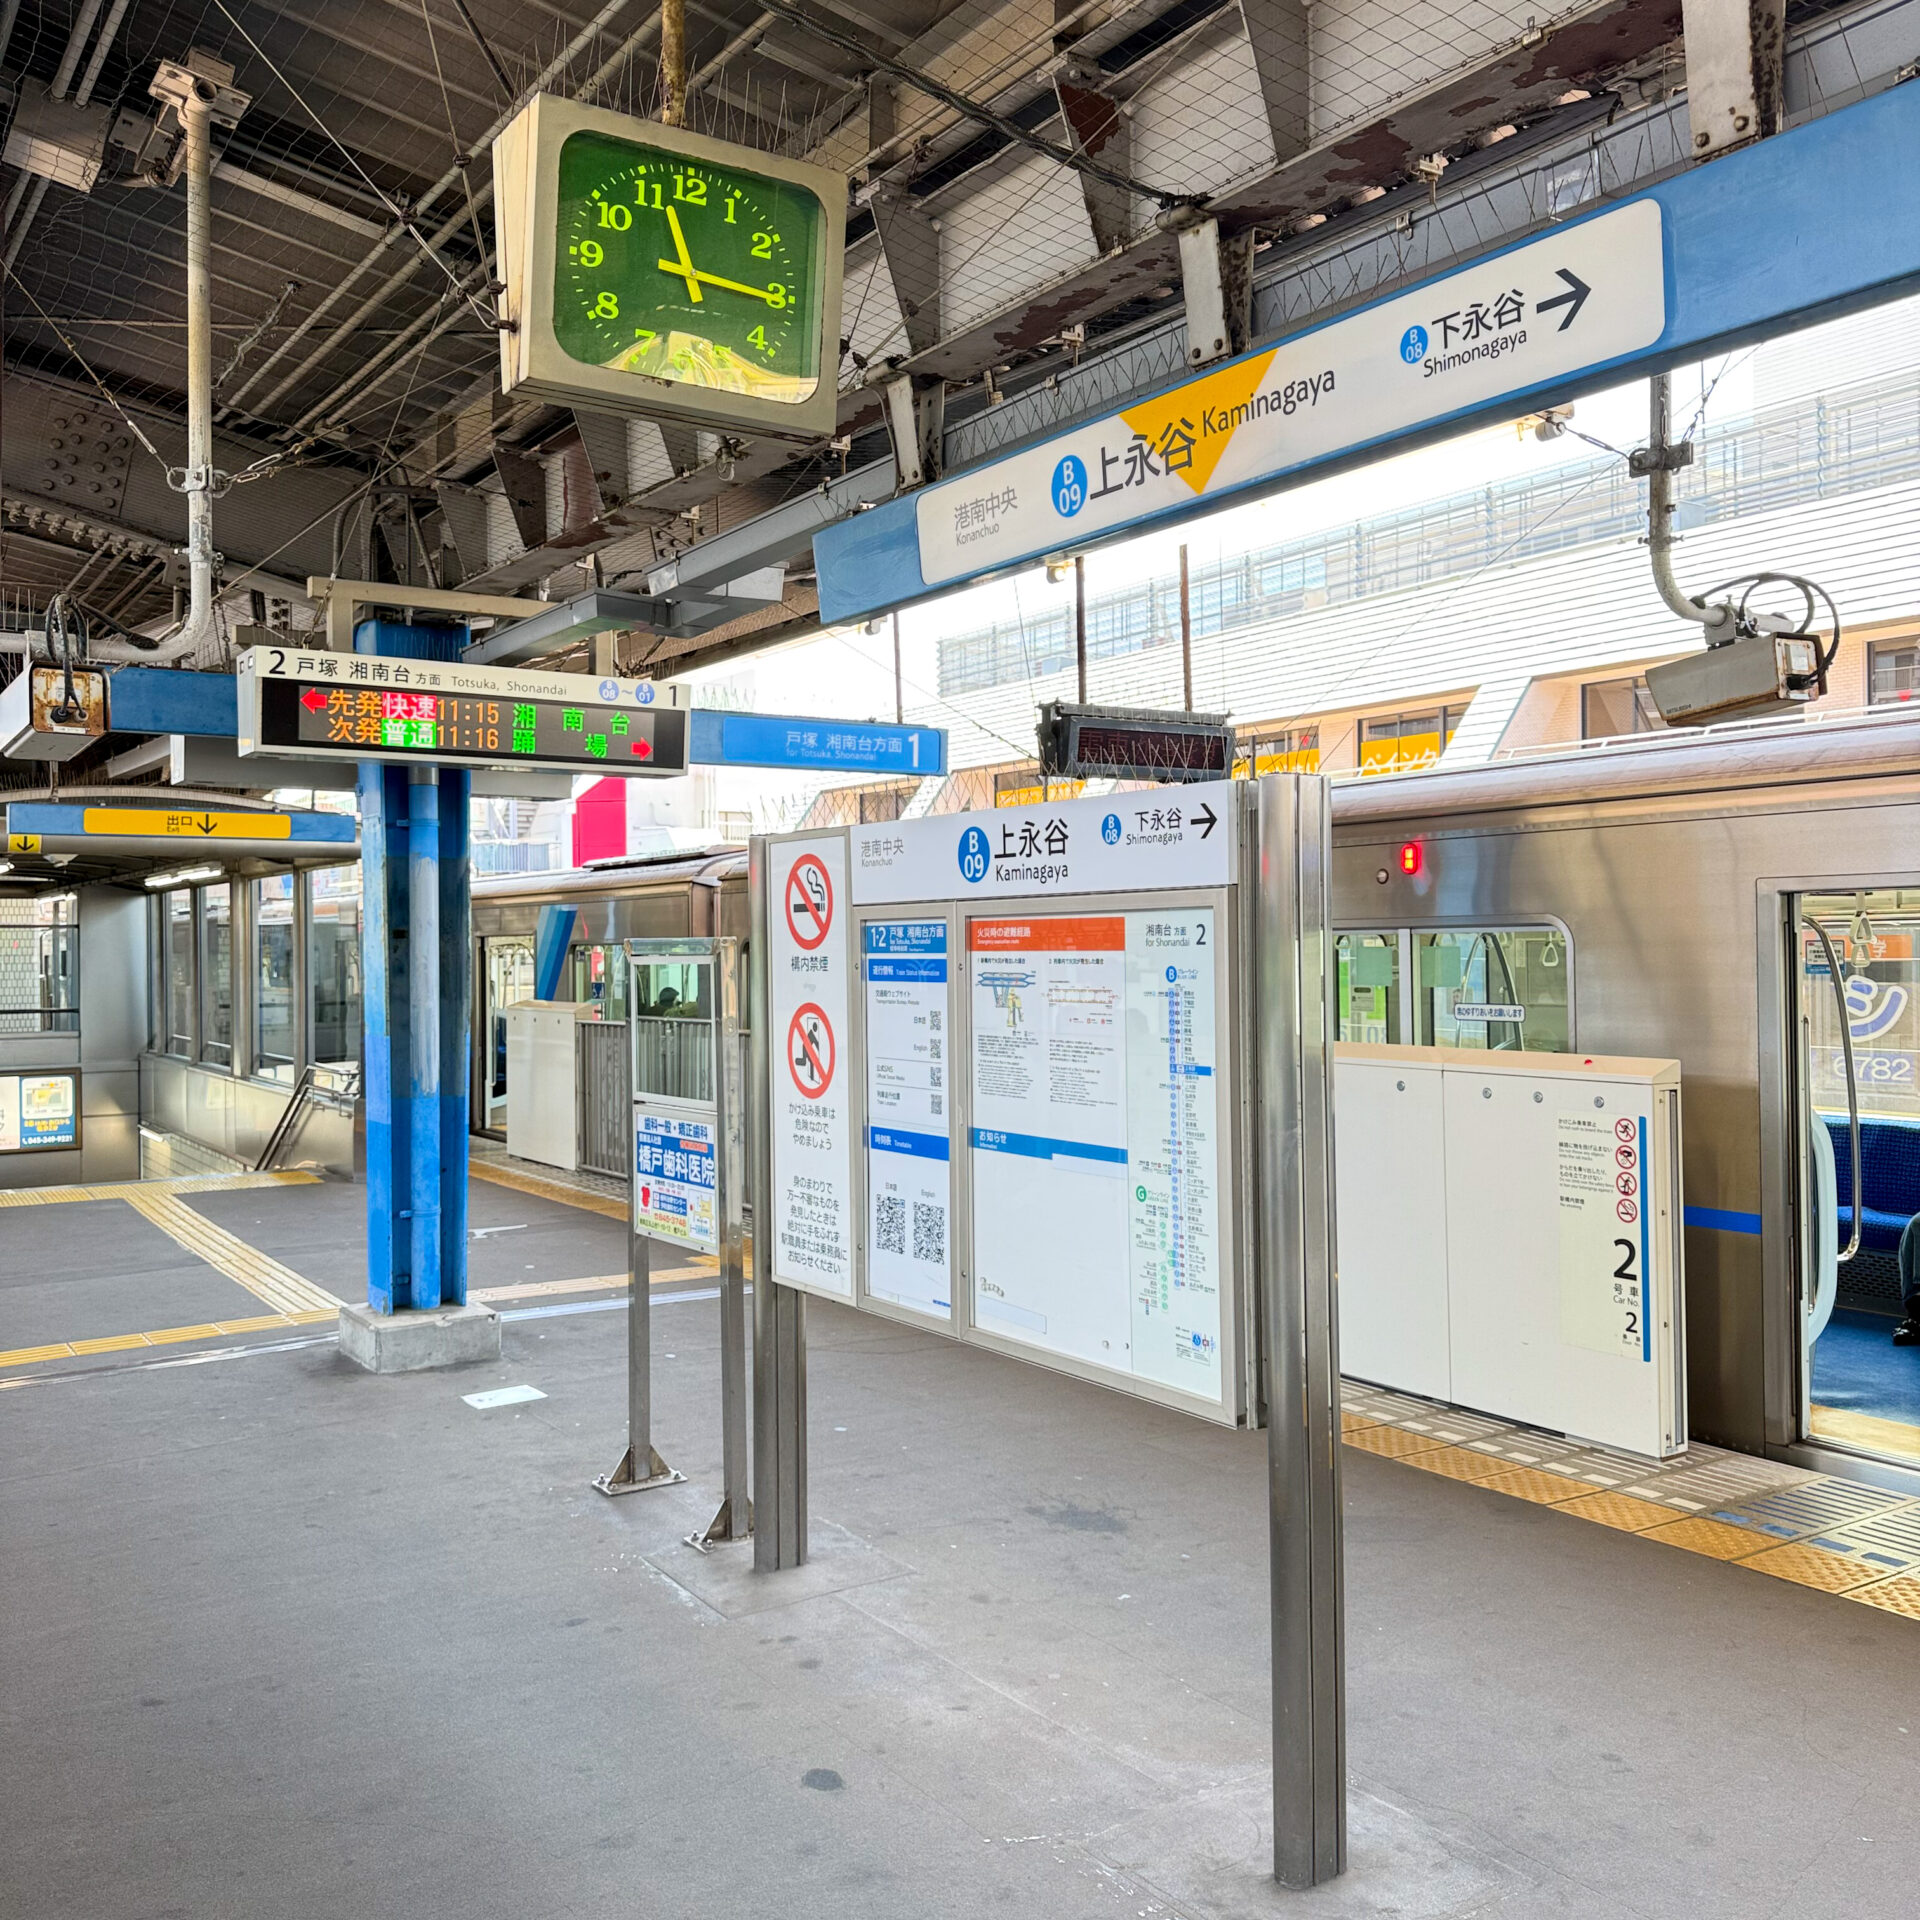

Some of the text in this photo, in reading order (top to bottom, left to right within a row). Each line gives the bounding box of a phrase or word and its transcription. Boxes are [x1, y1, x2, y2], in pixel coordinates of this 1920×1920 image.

[633, 178, 664, 210] 11
[672, 174, 709, 206] 12
[597, 200, 633, 231] 10
[723, 197, 738, 225] 1
[579, 239, 604, 268] 9
[751, 231, 772, 260] 2
[594, 291, 620, 320] 8
[765, 281, 788, 310] 3
[1431, 288, 1527, 350] 下永谷
[634, 327, 657, 356] 7
[746, 324, 768, 351] 4
[1409, 327, 1420, 343] B
[1405, 340, 1424, 362] 08
[1422, 328, 1528, 379] Shimonagaya
[1201, 367, 1337, 438] Kaminagaya
[1089, 417, 1198, 501] 上永谷
[1062, 460, 1074, 485] B
[953, 484, 1018, 532] 港南中央
[1057, 484, 1084, 514] 09
[955, 521, 1001, 548] Konanchuo
[268, 649, 568, 697] 2 戸塚 湘南台 方面 Totsuka, Shonandai
[667, 685, 679, 707] 1
[328, 689, 631, 736] 先発 快速 11:15 湘南台
[327, 716, 382, 745] 次発
[382, 719, 437, 748] 普通
[436, 725, 499, 750] 11:16
[786, 730, 920, 768] 戸塚 湘南台方面 1
[834, 750, 877, 761] Shonandai
[167, 815, 192, 826] 出口
[1107, 816, 1115, 829] B
[1135, 807, 1183, 832] 下永谷
[860, 836, 904, 857] 港南中央
[968, 831, 979, 853] B
[994, 817, 1070, 860] 上永谷
[1104, 828, 1119, 842] 08
[1126, 832, 1183, 847] Shimonagaya
[861, 857, 893, 868] Konanchuo
[963, 856, 985, 879] 09
[995, 863, 1069, 884] Kaminagaya
[889, 925, 944, 938] 戸塚 湘南台方面
[1145, 923, 1207, 946] 湘南台 方面 2
[1145, 938, 1191, 947] for Shonandai
[791, 956, 829, 972] 構内禁煙
[1168, 968, 1175, 979] B
[1833, 1055, 1912, 1082] 6782
[788, 1102, 836, 1120] かけ込み乗車は
[795, 1118, 829, 1134] 危険なので
[979, 1130, 1007, 1144] お知らせ
[792, 1133, 832, 1150] やめましょう
[638, 1144, 715, 1185] 橋戸歯科医院
[793, 1175, 833, 1194] 身のまわりで
[787, 1188, 840, 1212] 万一不審なものを
[790, 1204, 837, 1226] 発見したときは
[787, 1219, 840, 1243] 絶対に手をふれず
[787, 1250, 841, 1274] お知らせください
[1613, 1238, 1638, 1282] 2
[1612, 1294, 1640, 1308] Car No.
[1613, 1283, 1640, 1298] 号車
[1625, 1311, 1638, 1334] 2
